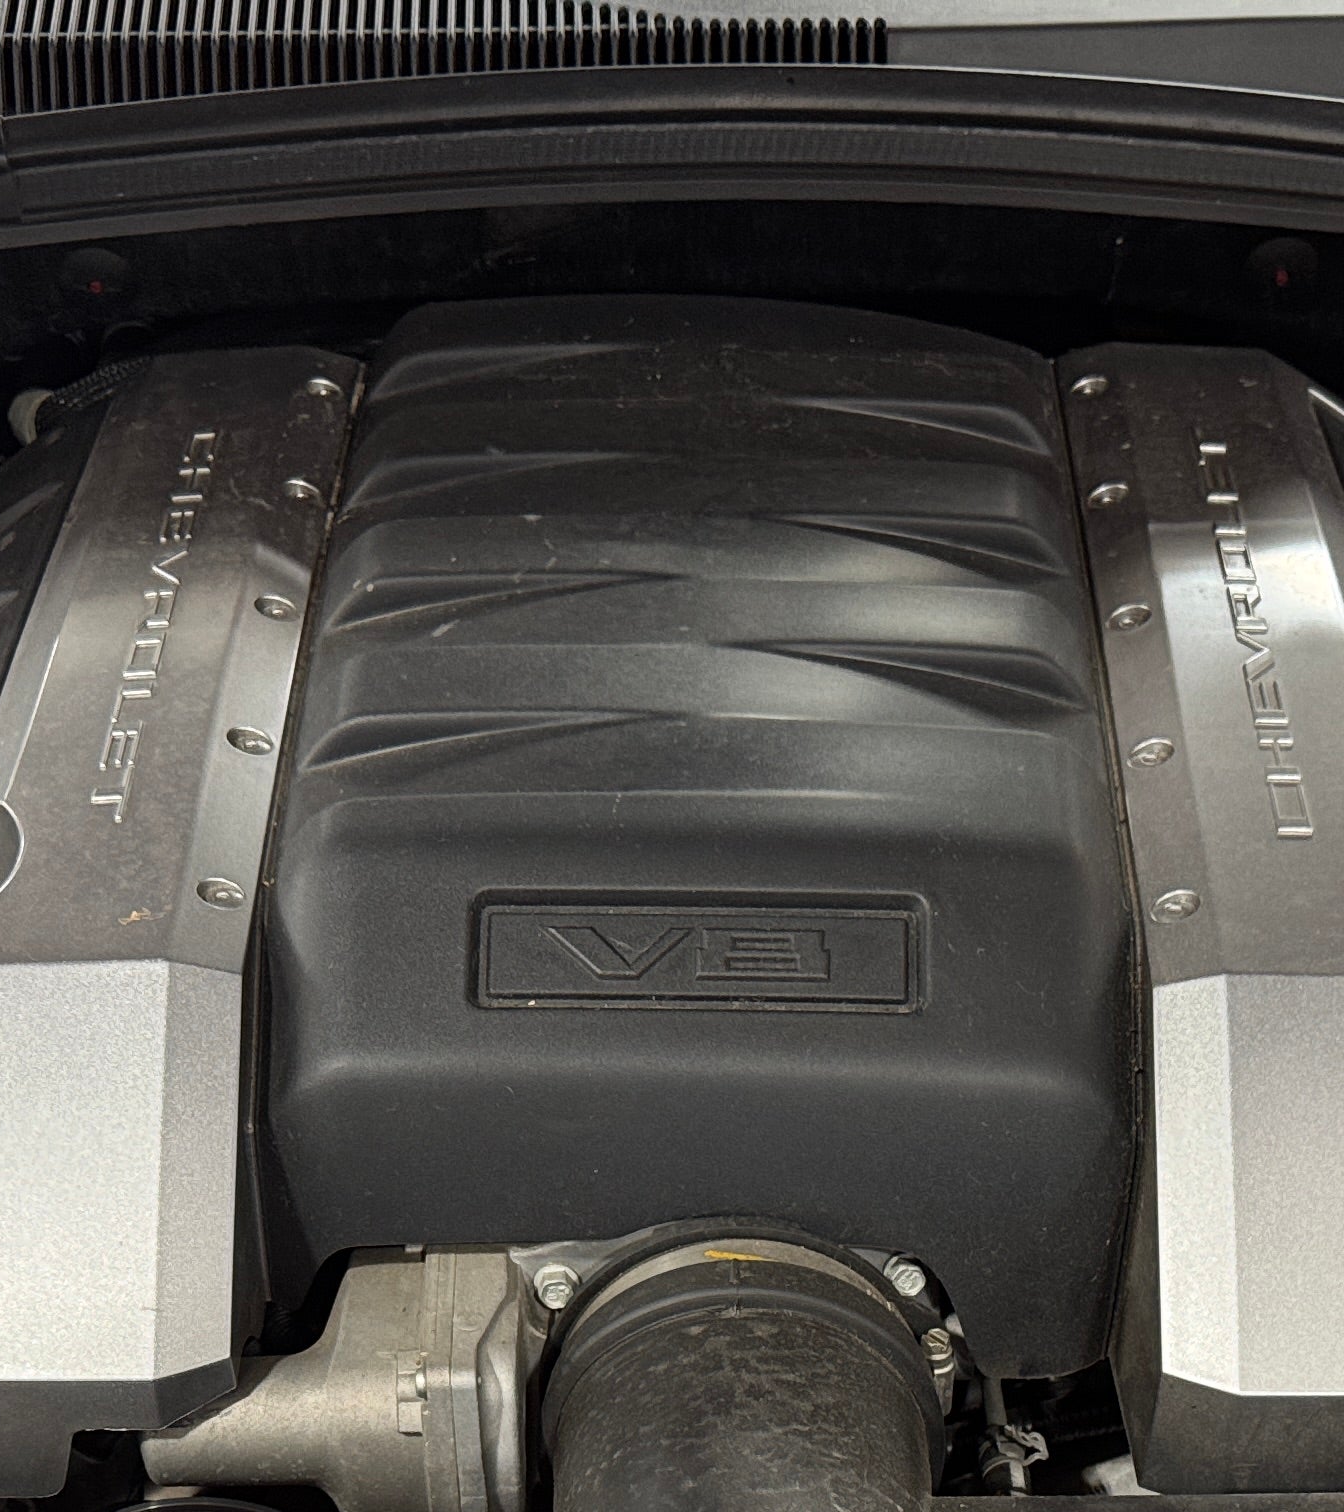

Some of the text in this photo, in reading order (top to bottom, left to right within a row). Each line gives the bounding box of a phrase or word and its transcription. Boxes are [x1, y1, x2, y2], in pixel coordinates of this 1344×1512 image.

[90, 431, 219, 823] CHEVROLET
[1193, 430, 1316, 841] CHEVROLET
[536, 924, 832, 984] V8
